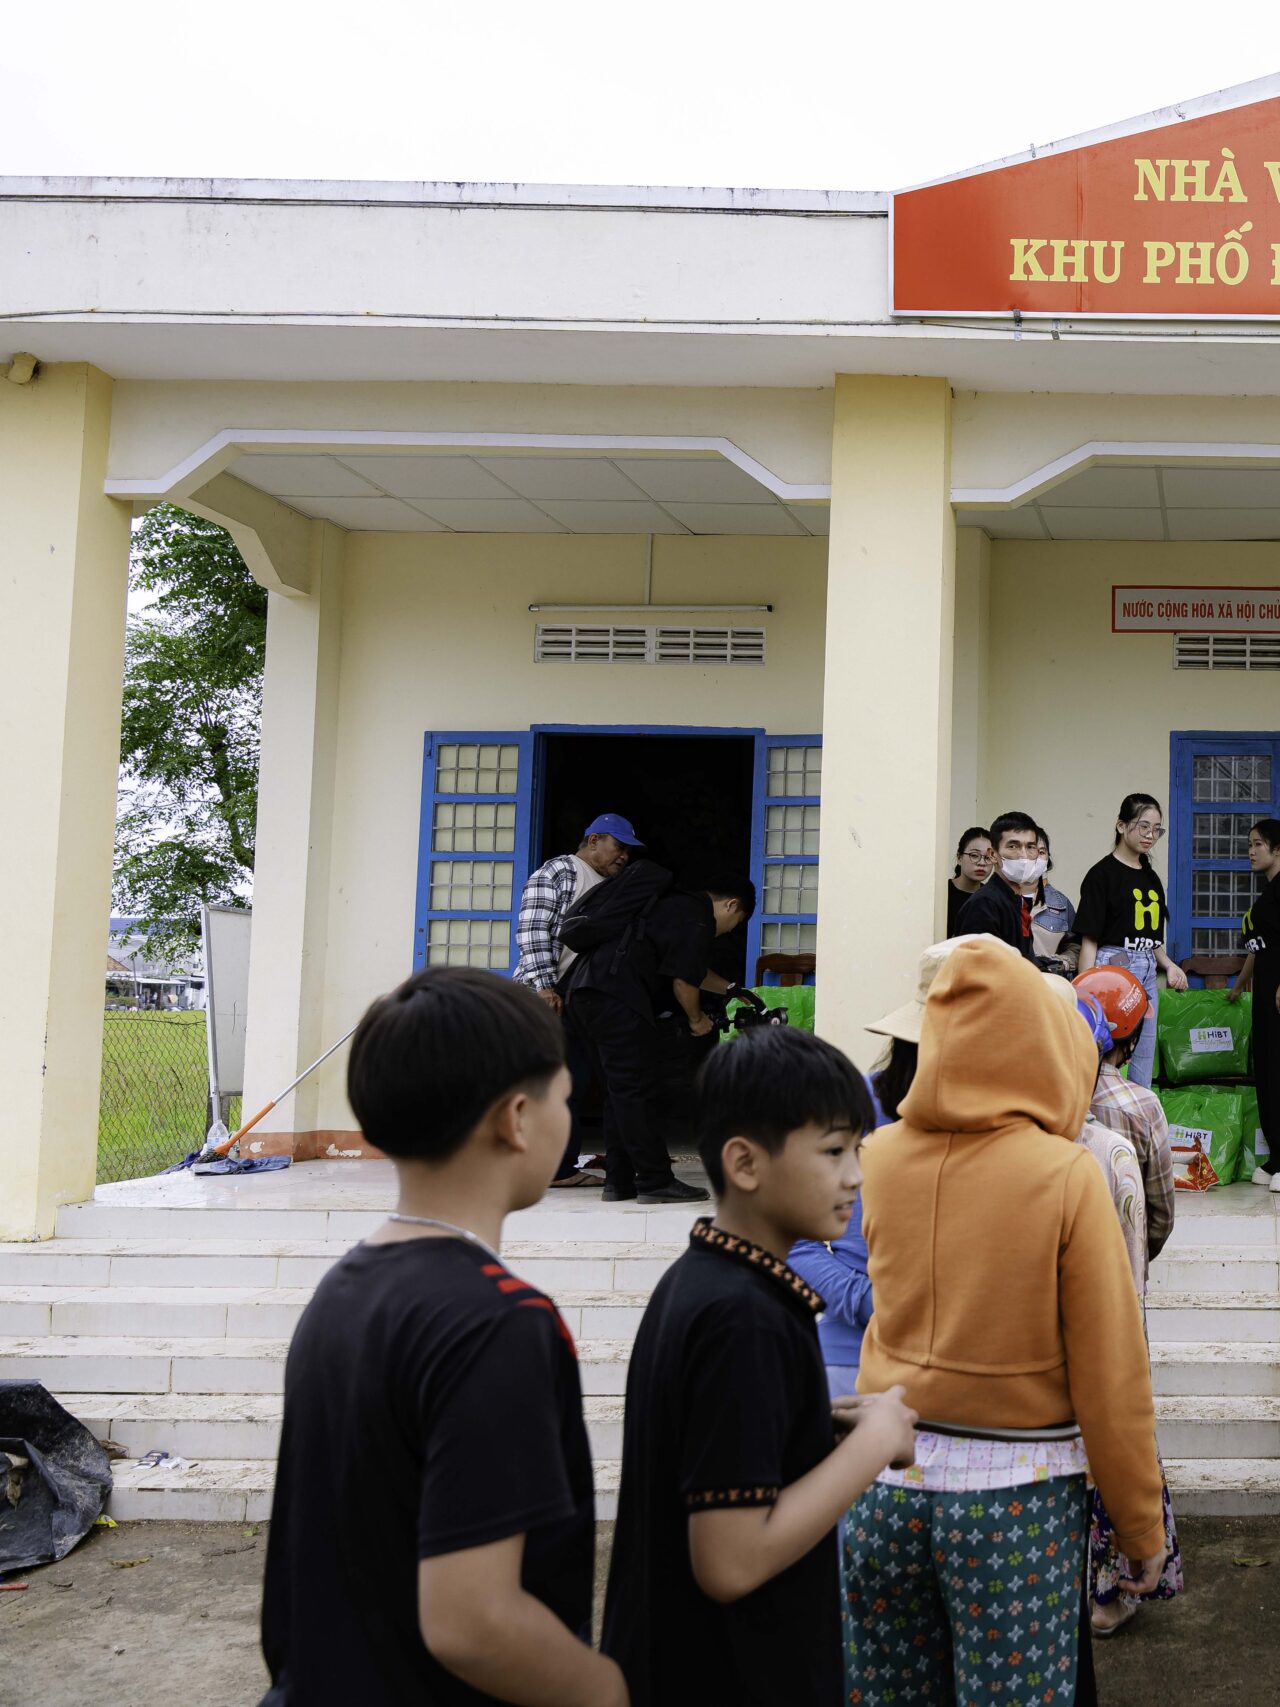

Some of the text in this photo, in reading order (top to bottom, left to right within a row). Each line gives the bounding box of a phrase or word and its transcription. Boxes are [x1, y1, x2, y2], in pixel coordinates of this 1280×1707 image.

[1134, 146, 1248, 203] NHÀ
[1009, 239, 1124, 283] KHU
[1143, 221, 1253, 286] PHỐ
[1122, 600, 1153, 617] NƯỚC
[1157, 600, 1188, 621] CỘNG
[1191, 600, 1215, 618] HÒA
[1217, 601, 1233, 618] XÃ
[1236, 601, 1255, 622] HỘI
